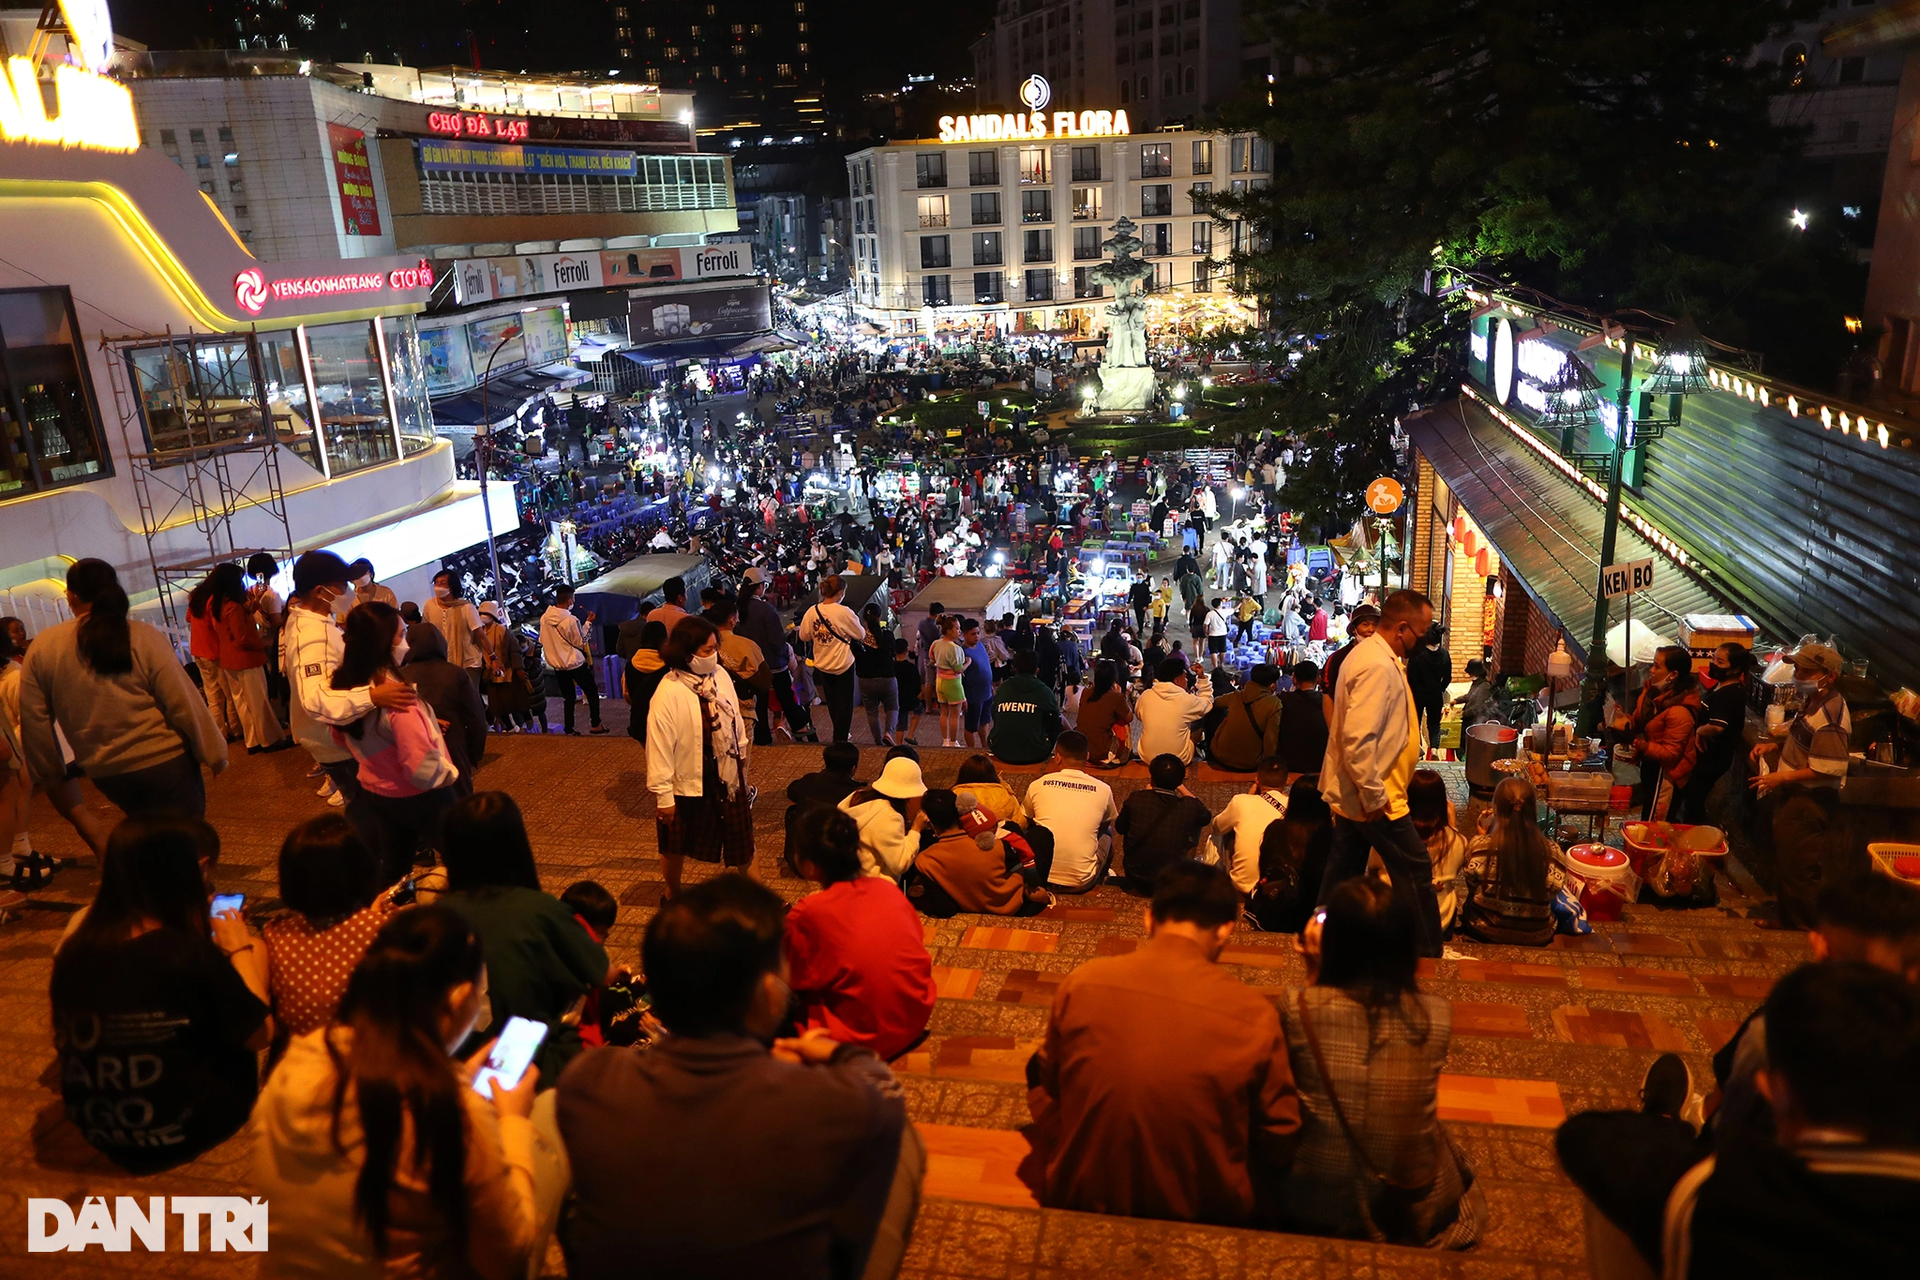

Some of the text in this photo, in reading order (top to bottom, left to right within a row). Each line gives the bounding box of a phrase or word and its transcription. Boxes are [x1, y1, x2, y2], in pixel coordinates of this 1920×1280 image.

[428, 112, 461, 138] CHỢ
[465, 113, 492, 135] ĐÀ
[495, 119, 529, 142] LẠT
[938, 109, 1130, 142] SANDALS FLORA
[554, 259, 590, 289] Ferroli
[696, 250, 739, 276] Ferroli
[271, 274, 383, 299] YENSAONHATRANG
[389, 268, 417, 290] CTCP
[464, 266, 485, 301] Ferroli
